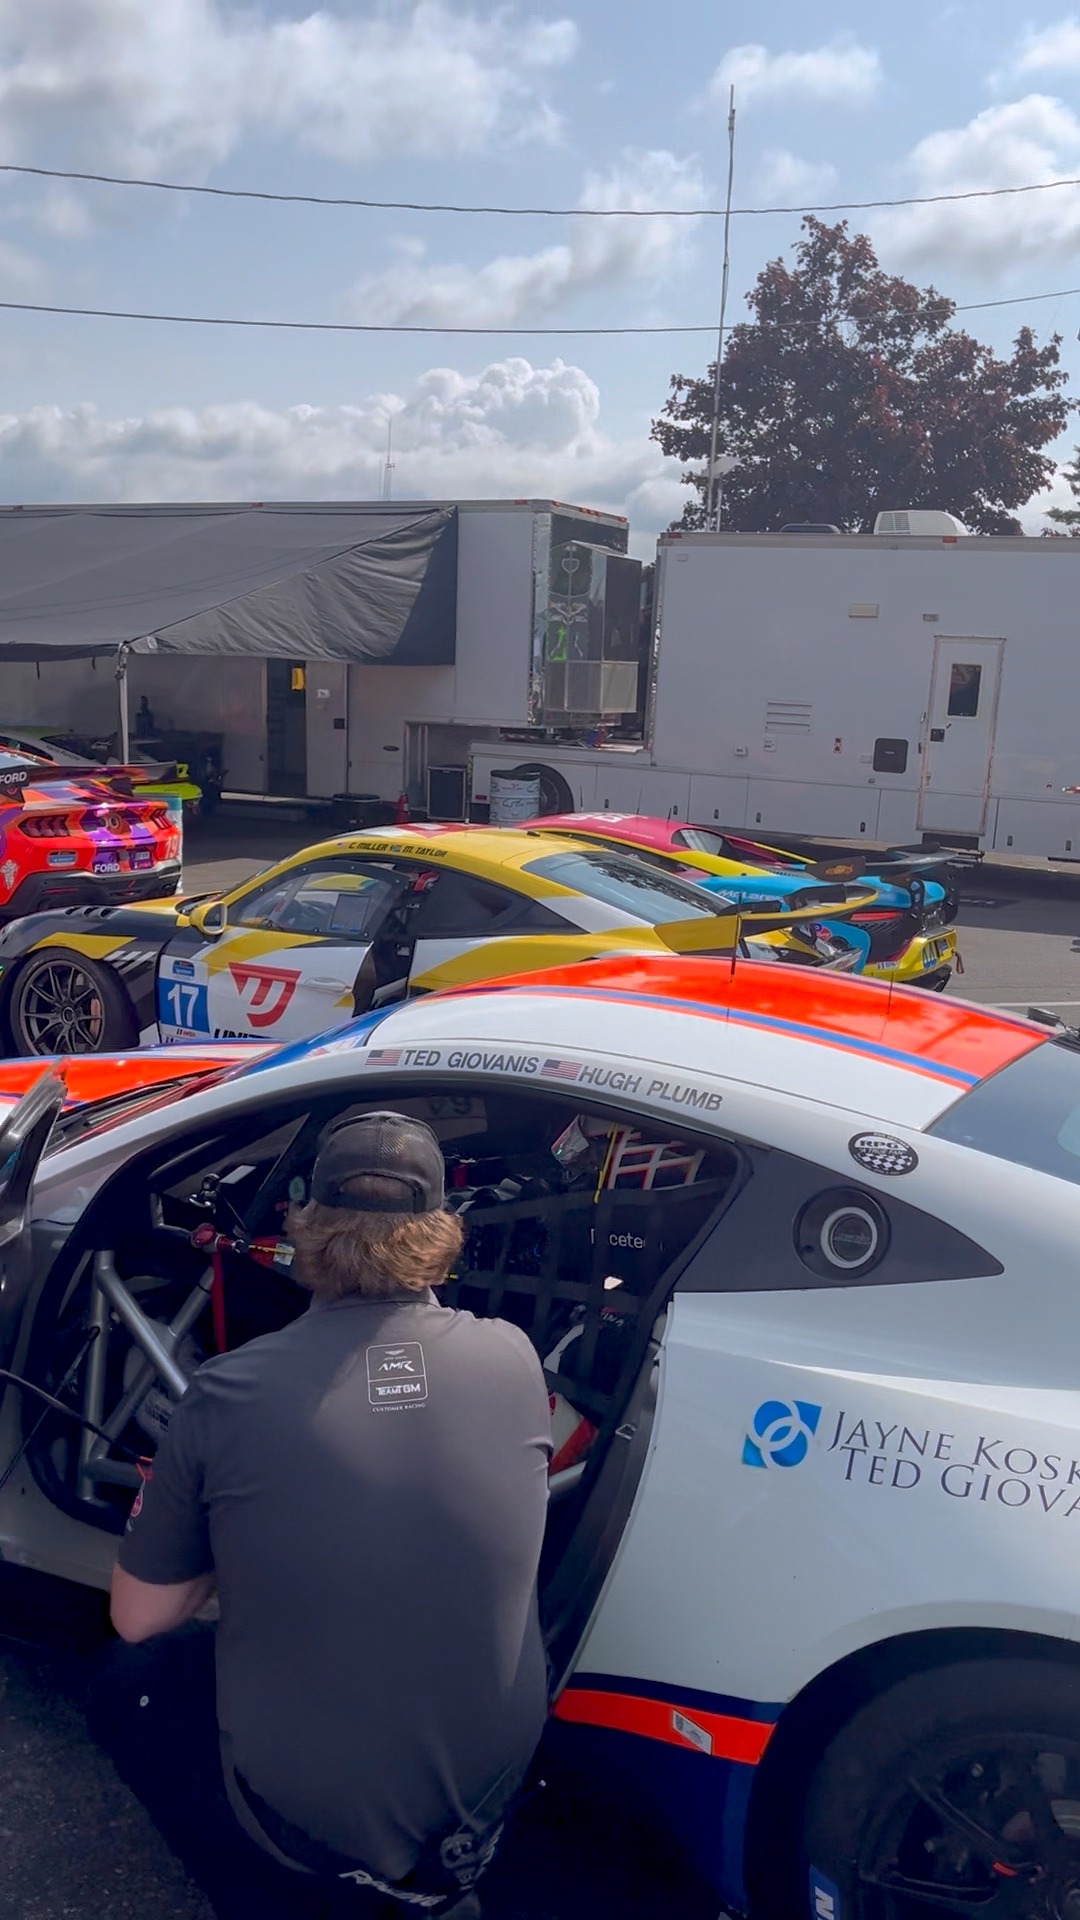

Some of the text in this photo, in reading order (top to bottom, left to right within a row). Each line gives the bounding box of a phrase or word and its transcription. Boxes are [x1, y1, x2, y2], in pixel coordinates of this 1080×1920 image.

[415, 847, 448, 858] TAYLOR
[94, 863, 120, 873] FORD
[167, 983, 199, 1028] 17
[403, 1050, 540, 1074] TED GIOVANIS
[578, 1065, 724, 1112] HUGH PLUMB
[860, 1140, 899, 1149] RPG
[378, 1360, 415, 1372] AMR
[827, 1411, 955, 1460] JAYNE
[840, 1445, 921, 1489] TED
